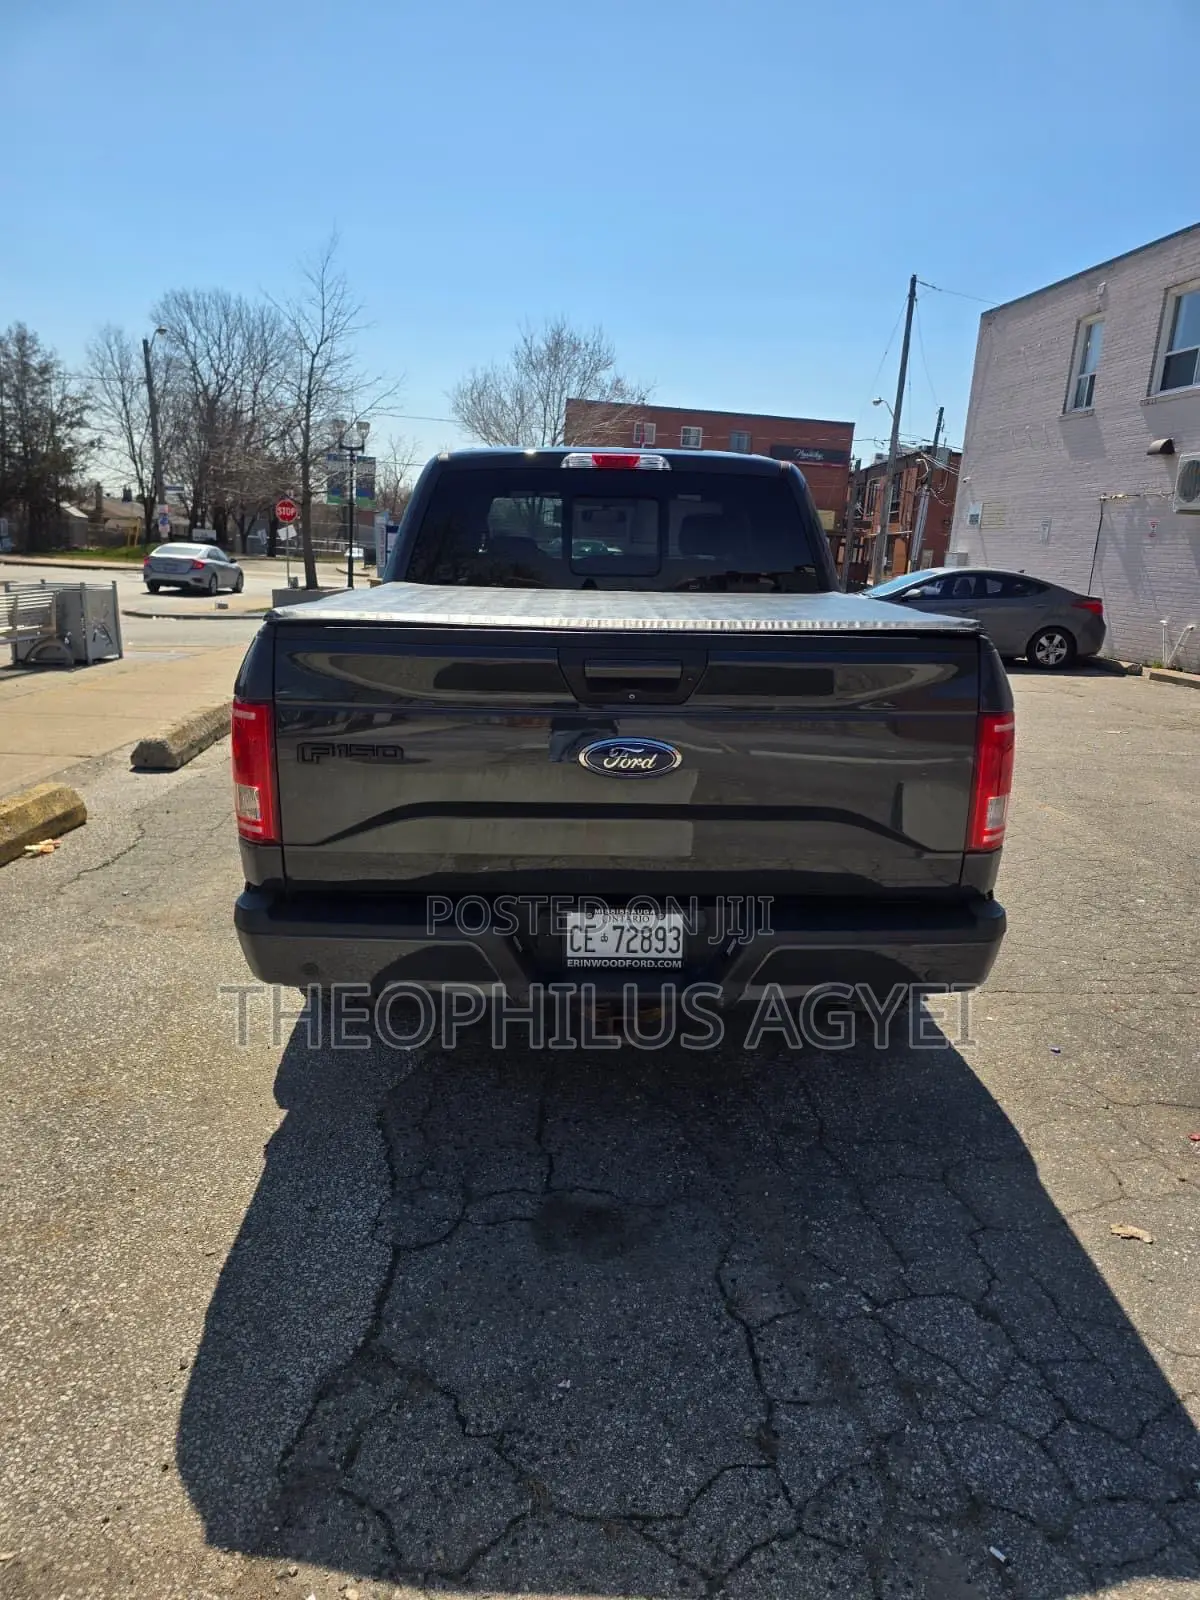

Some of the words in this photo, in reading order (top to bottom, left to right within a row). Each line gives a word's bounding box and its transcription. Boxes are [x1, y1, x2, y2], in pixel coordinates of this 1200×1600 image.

[277, 506, 296, 516] STOP
[603, 747, 658, 769] Ford
[602, 914, 650, 923] ONTARIO
[569, 924, 597, 953] CE
[612, 925, 681, 954] 72893
[567, 959, 682, 969] ERINWOODFORD.COM
